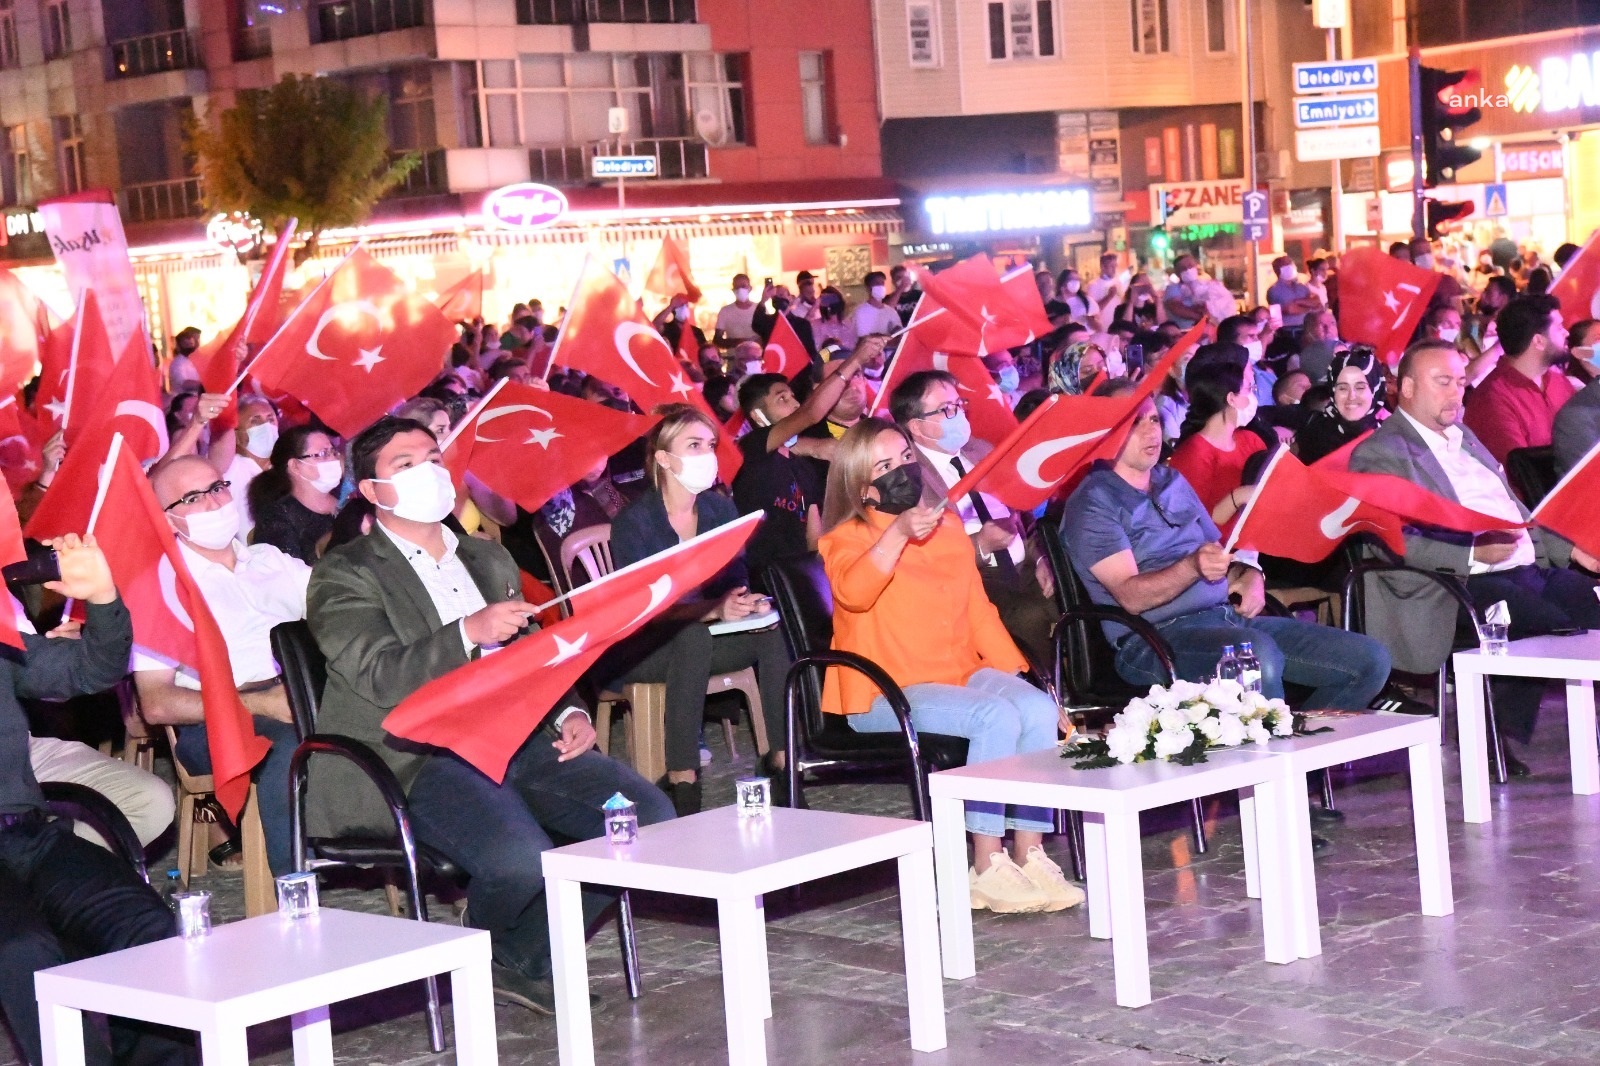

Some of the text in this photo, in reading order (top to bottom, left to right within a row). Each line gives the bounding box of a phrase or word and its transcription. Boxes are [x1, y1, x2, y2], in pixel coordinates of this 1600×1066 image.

[1299, 69, 1360, 87] Belediye
[1541, 50, 1600, 112] BA
[1300, 102, 1362, 120] Emniyet
